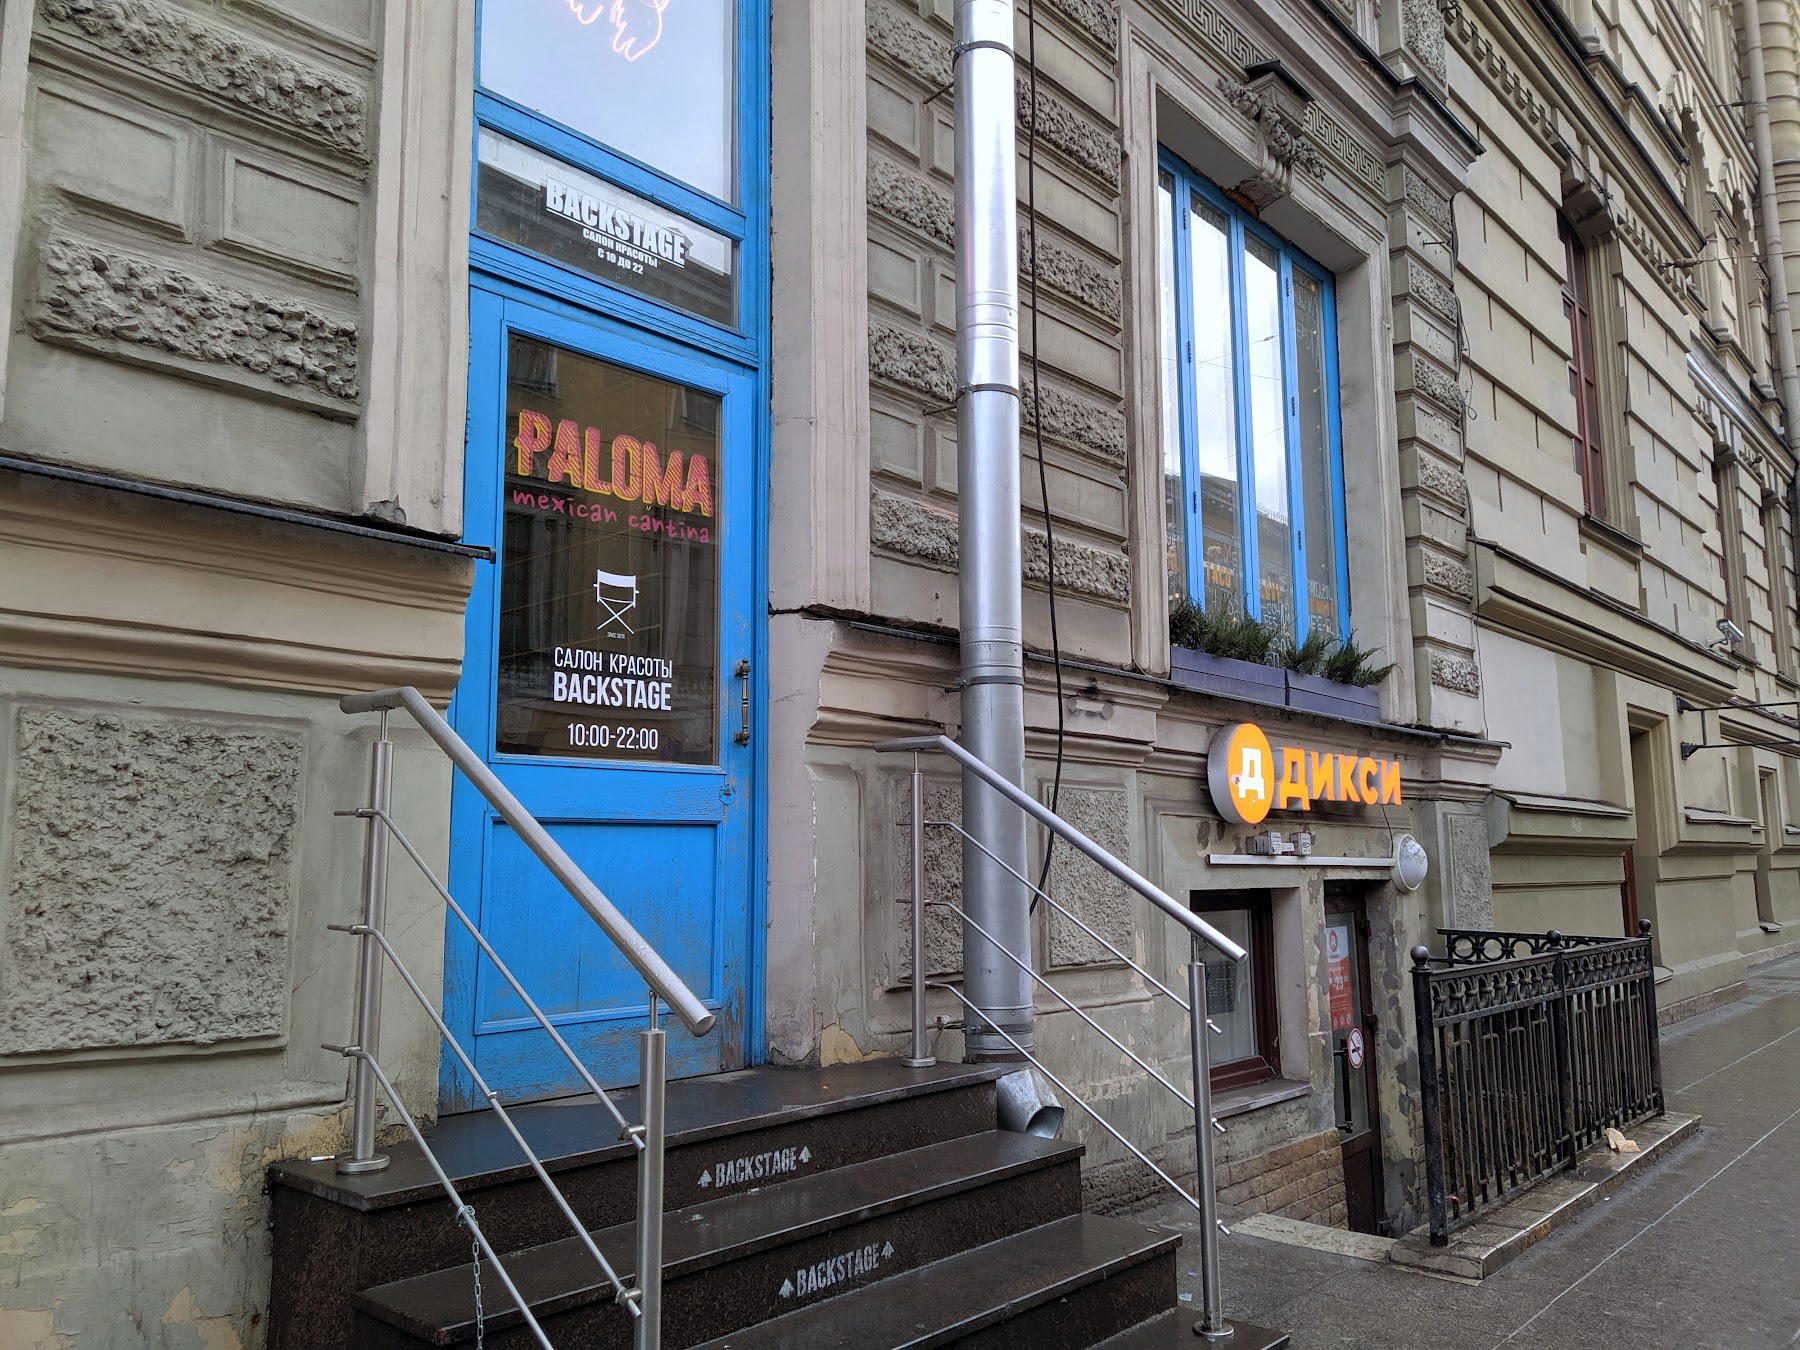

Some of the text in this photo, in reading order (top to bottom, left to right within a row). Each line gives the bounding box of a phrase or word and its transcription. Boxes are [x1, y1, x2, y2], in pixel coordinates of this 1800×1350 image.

[546, 179, 685, 266] BACKSTAGE
[582, 227, 658, 268] САЛОН КРАСОТЫ
[597, 247, 644, 275] С 10 ДО 22
[514, 408, 714, 517] PALOMA
[513, 489, 710, 544] mexican cantina
[554, 646, 673, 679] САЛОН КРАСОТЫ
[553, 671, 672, 711] BACKSTAGE
[567, 722, 659, 750] 10:00-22:00
[1238, 746, 1402, 811] Д ДИКСИ
[715, 1146, 797, 1188] BACKSTAGE
[796, 1243, 880, 1297] BACKSTAGE
